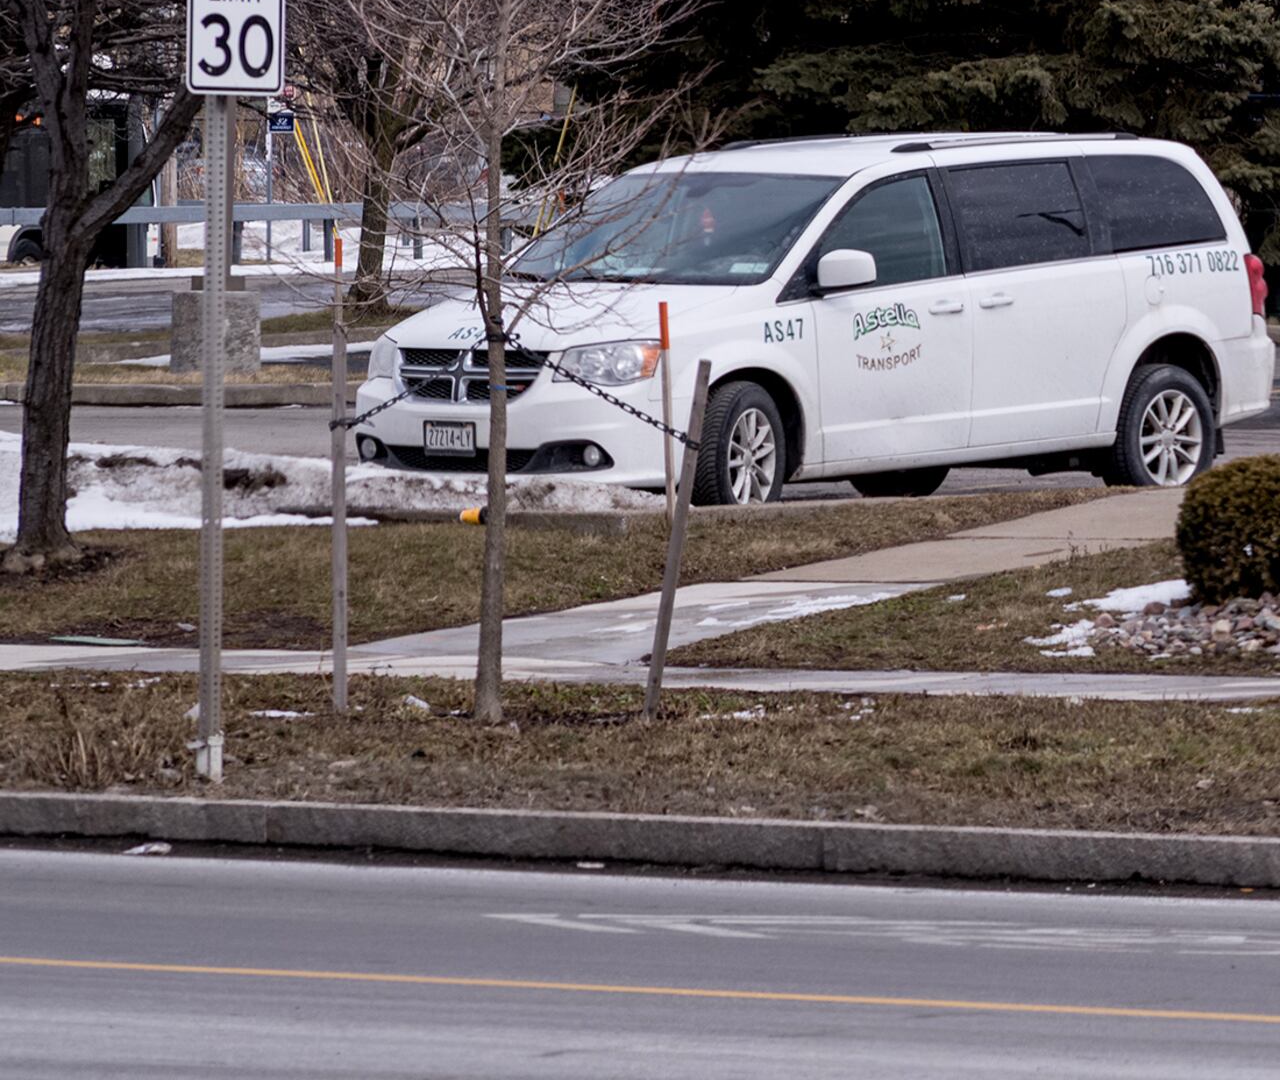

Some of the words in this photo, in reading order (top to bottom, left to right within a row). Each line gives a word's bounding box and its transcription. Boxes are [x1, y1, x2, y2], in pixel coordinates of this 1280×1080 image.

[198, 13, 274, 78] 30
[1145, 254, 1174, 276] 716
[1176, 252, 1202, 274] 371
[1206, 250, 1239, 272] 0822
[764, 318, 804, 343] AS47
[854, 303, 921, 340] Astella
[856, 344, 922, 371] TRANSPORT
